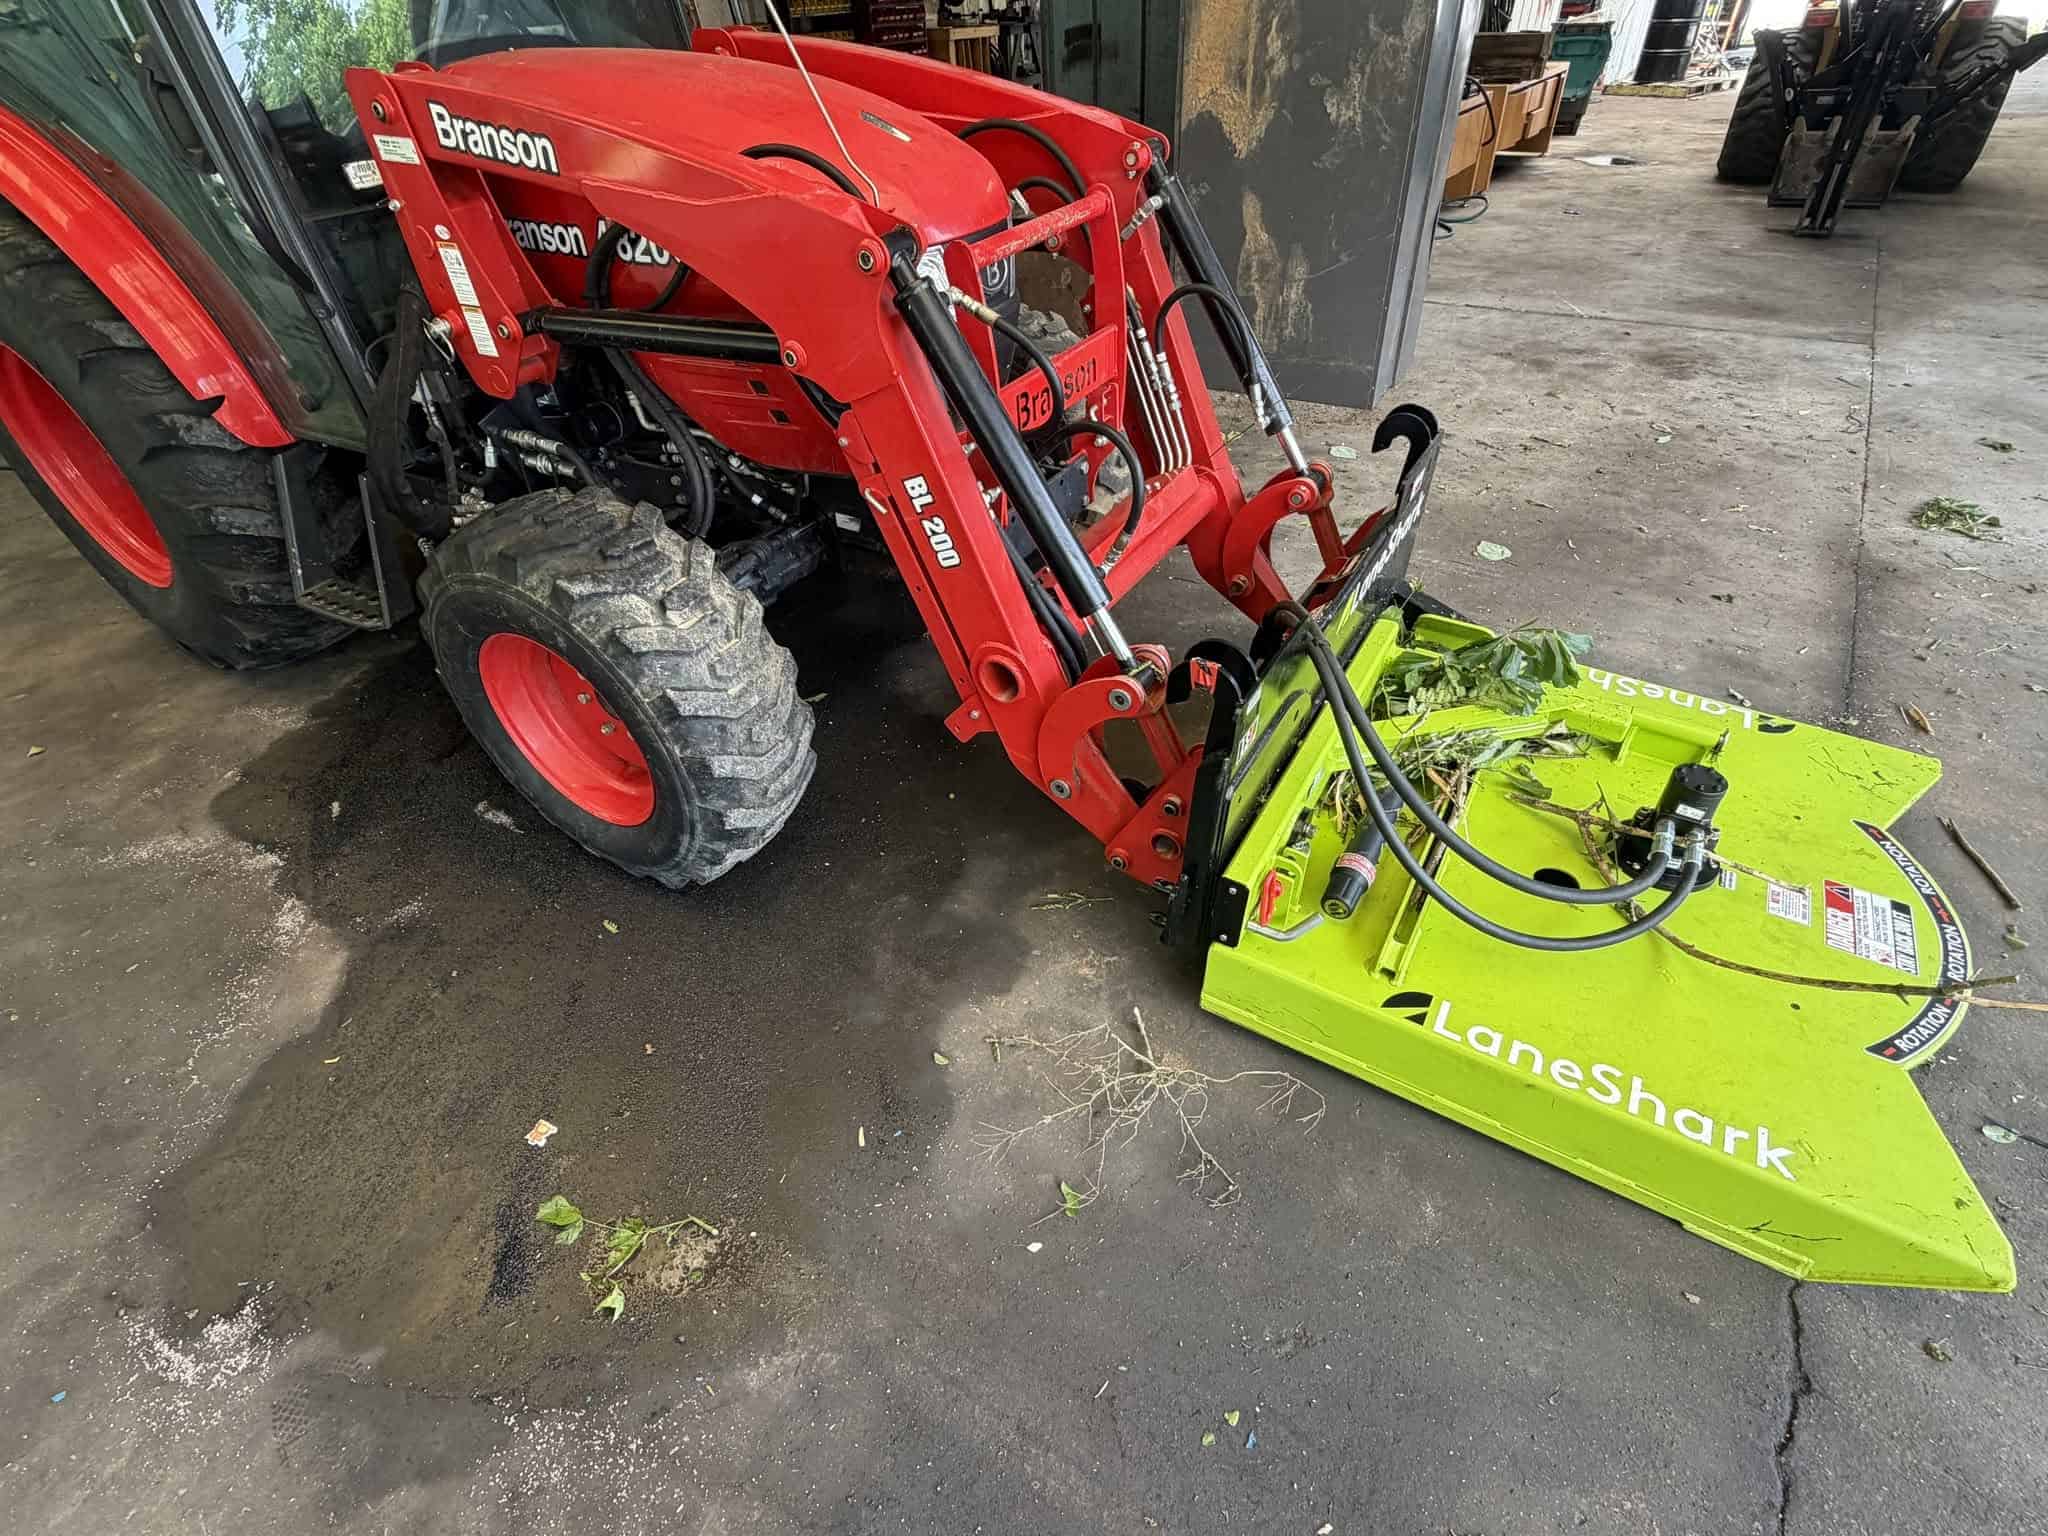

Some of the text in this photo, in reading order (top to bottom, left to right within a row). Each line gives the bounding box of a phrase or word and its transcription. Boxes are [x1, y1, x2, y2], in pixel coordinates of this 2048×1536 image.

[428, 101, 559, 175] Branson
[507, 220, 587, 257] anson
[1016, 357, 1097, 432] Brason
[903, 475, 961, 568] BL 200
[1588, 667, 1753, 729] LaneSh
[1880, 839, 1936, 896] ROTATION
[1946, 924, 1963, 983] ROTATION
[1893, 1003, 1951, 1052] ROTATION
[1432, 1000, 1797, 1182] LaneShark
